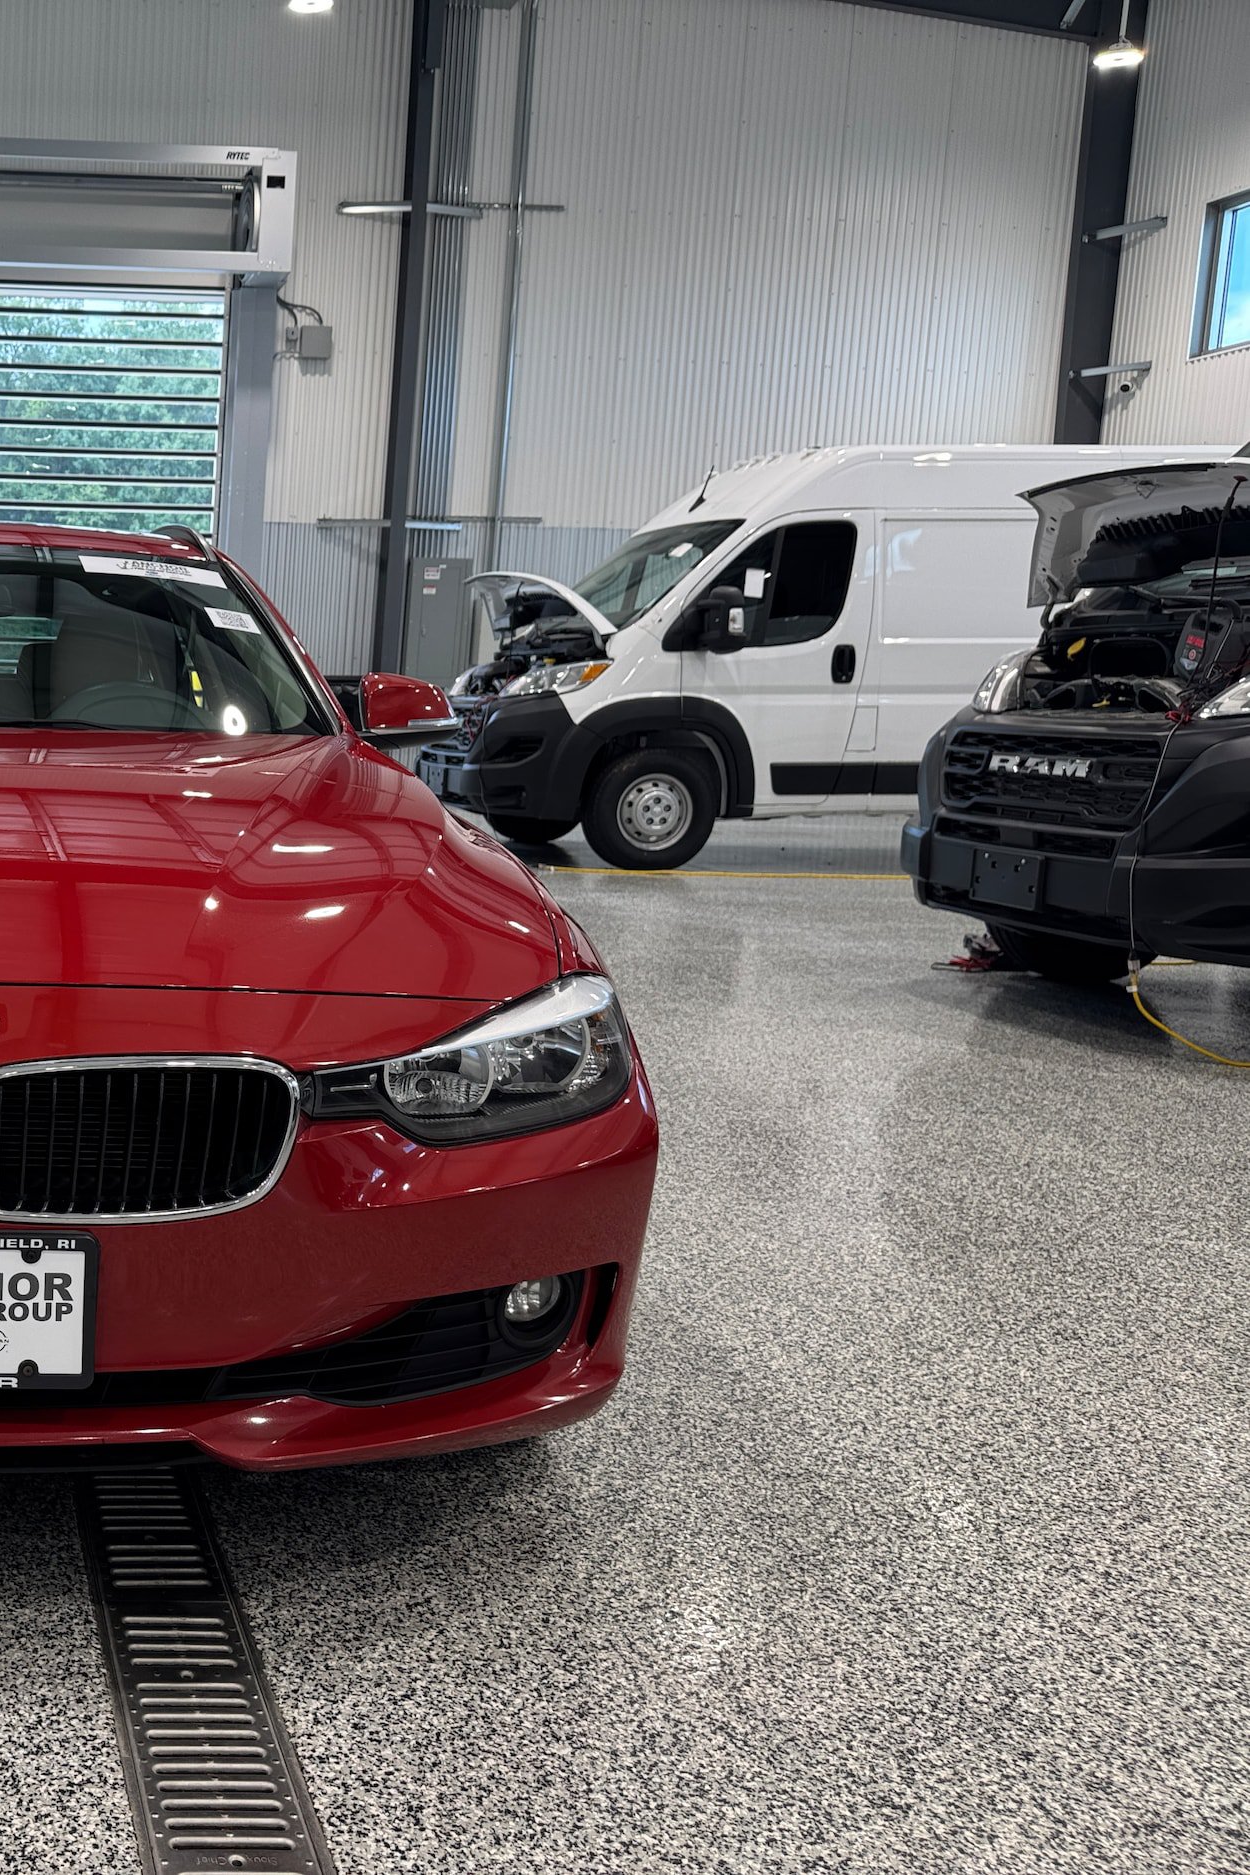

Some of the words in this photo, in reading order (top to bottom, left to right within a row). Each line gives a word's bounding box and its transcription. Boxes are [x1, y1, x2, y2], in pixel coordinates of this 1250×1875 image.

[226, 151, 251, 160] RYTEC
[988, 754, 1091, 778] RAM
[57, 1239, 76, 1249] RI
